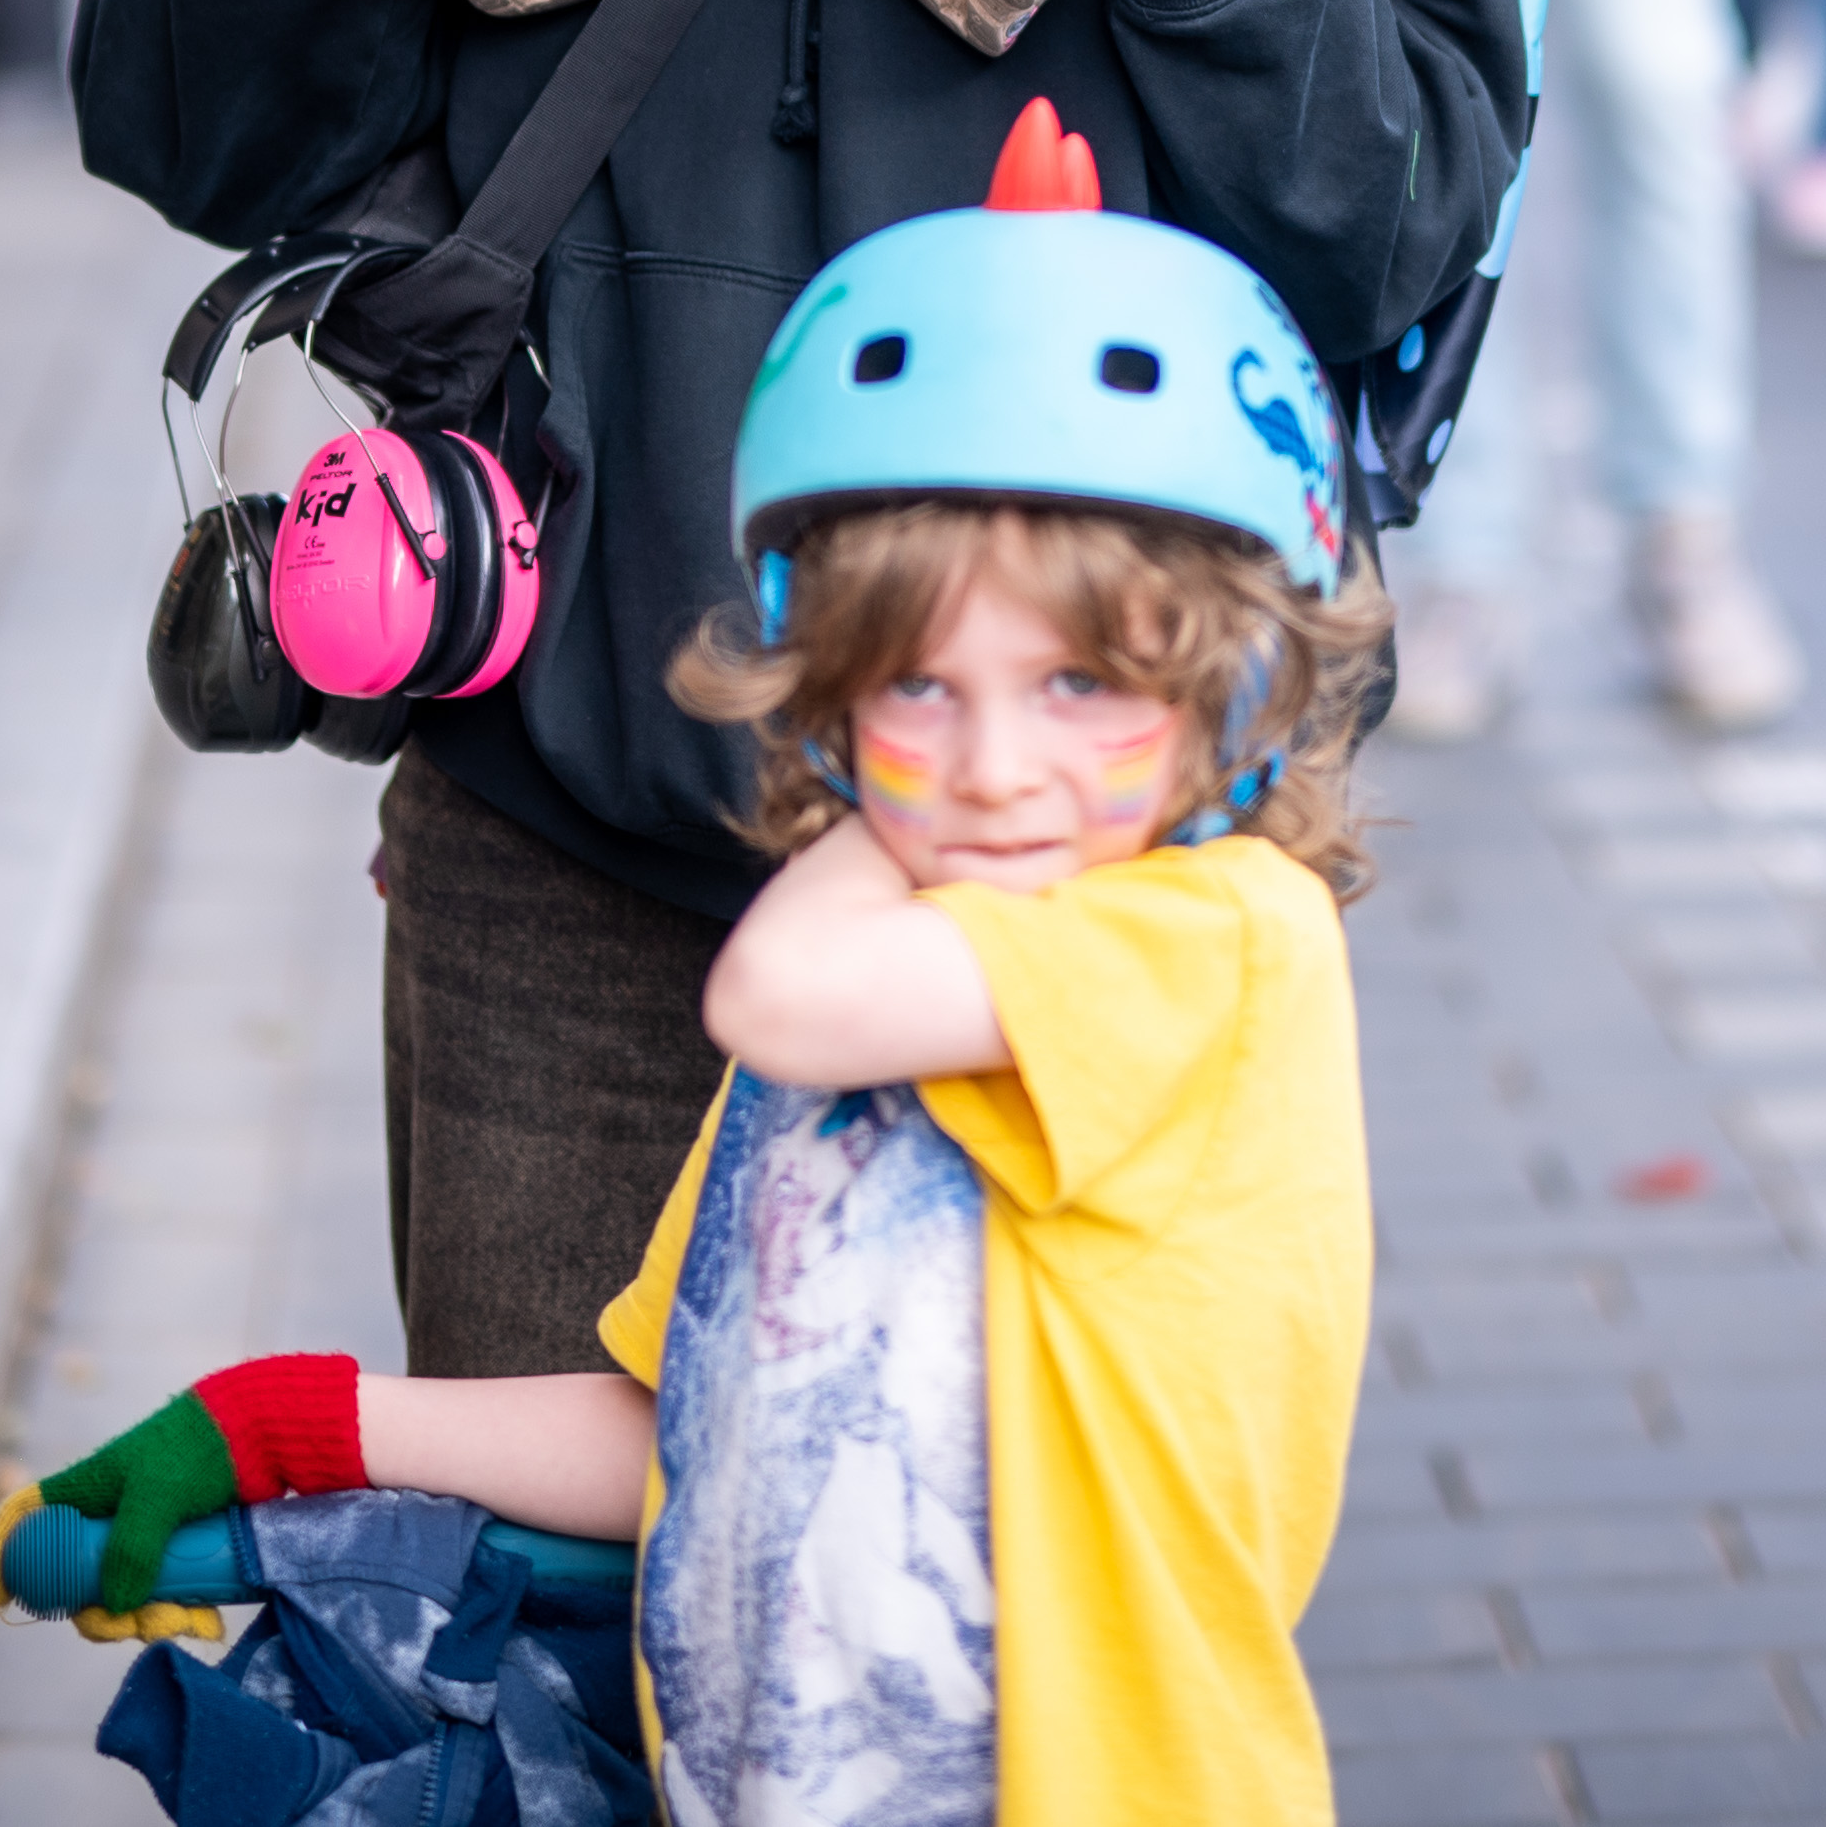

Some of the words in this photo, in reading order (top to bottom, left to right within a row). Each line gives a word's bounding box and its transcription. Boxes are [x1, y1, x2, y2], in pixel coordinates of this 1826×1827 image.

[324, 451, 346, 468] 3M
[309, 470, 353, 482] PELTOR
[295, 482, 357, 528] kid
